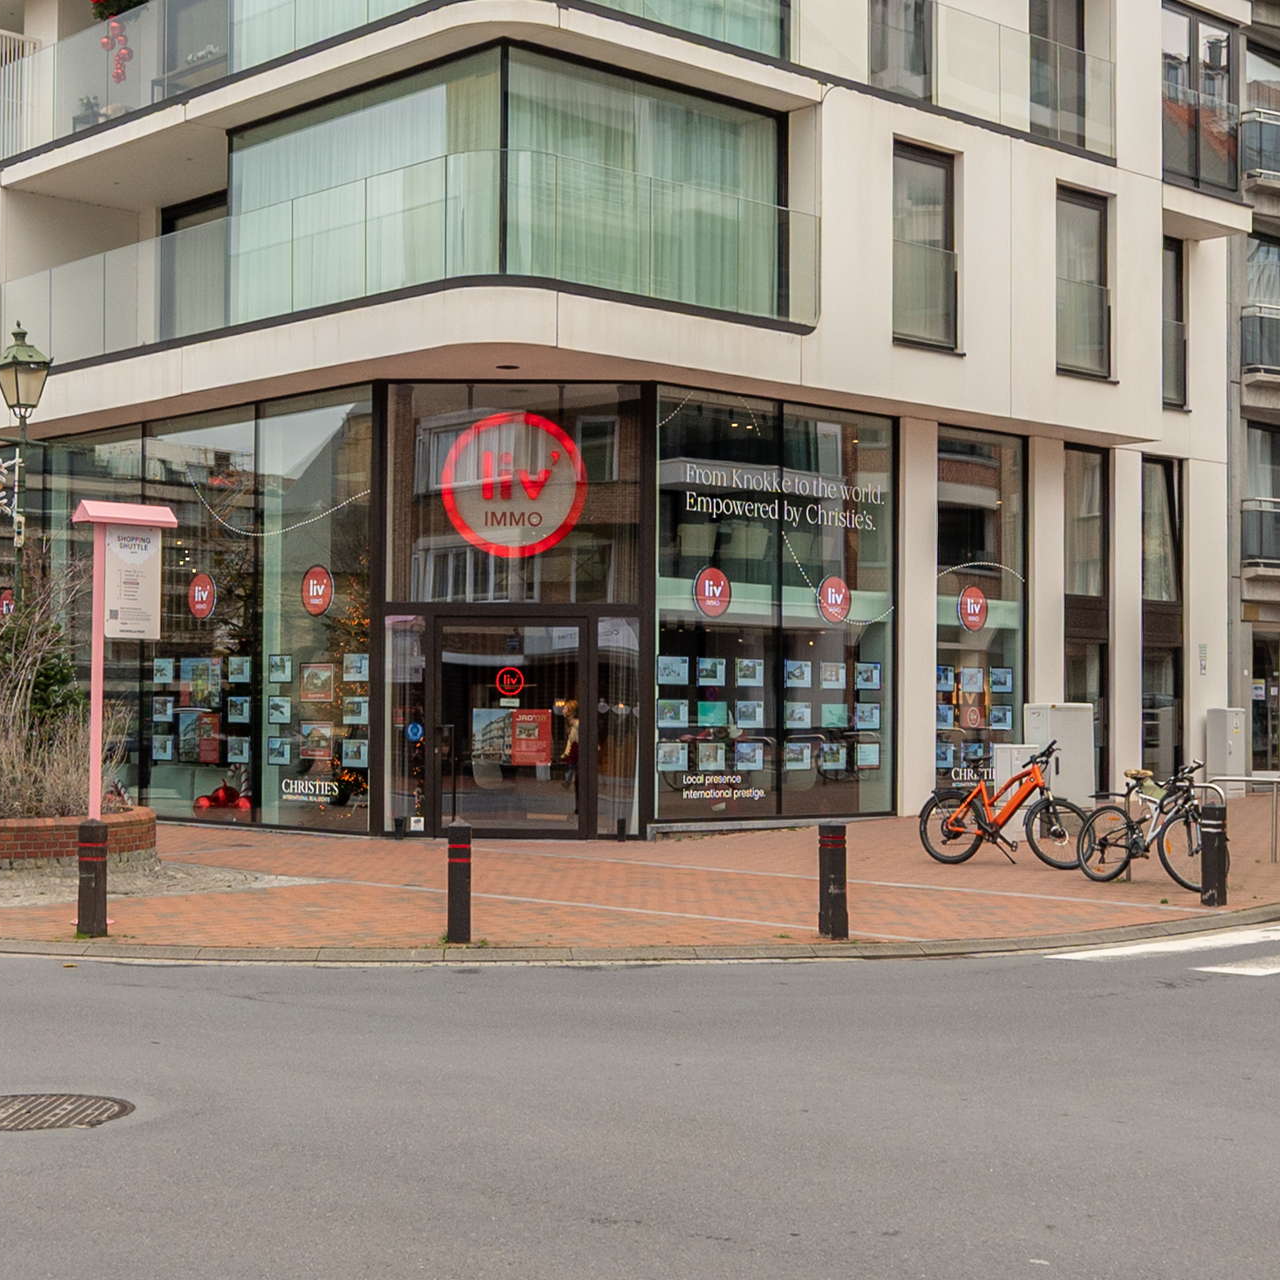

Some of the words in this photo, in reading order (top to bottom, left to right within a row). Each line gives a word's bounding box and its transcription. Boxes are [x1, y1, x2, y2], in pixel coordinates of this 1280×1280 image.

[685, 463, 727, 488] From
[732, 468, 792, 494] Knokke
[795, 477, 810, 496] to
[813, 477, 837, 500] the
[840, 483, 885, 505] world.
[484, 511, 543, 527] IMMO
[686, 491, 779, 518] Empowered
[783, 500, 802, 528] by
[806, 504, 876, 531] Christie's.
[683, 774, 704, 784] Local
[705, 775, 742, 786] presence
[682, 788, 732, 799] international
